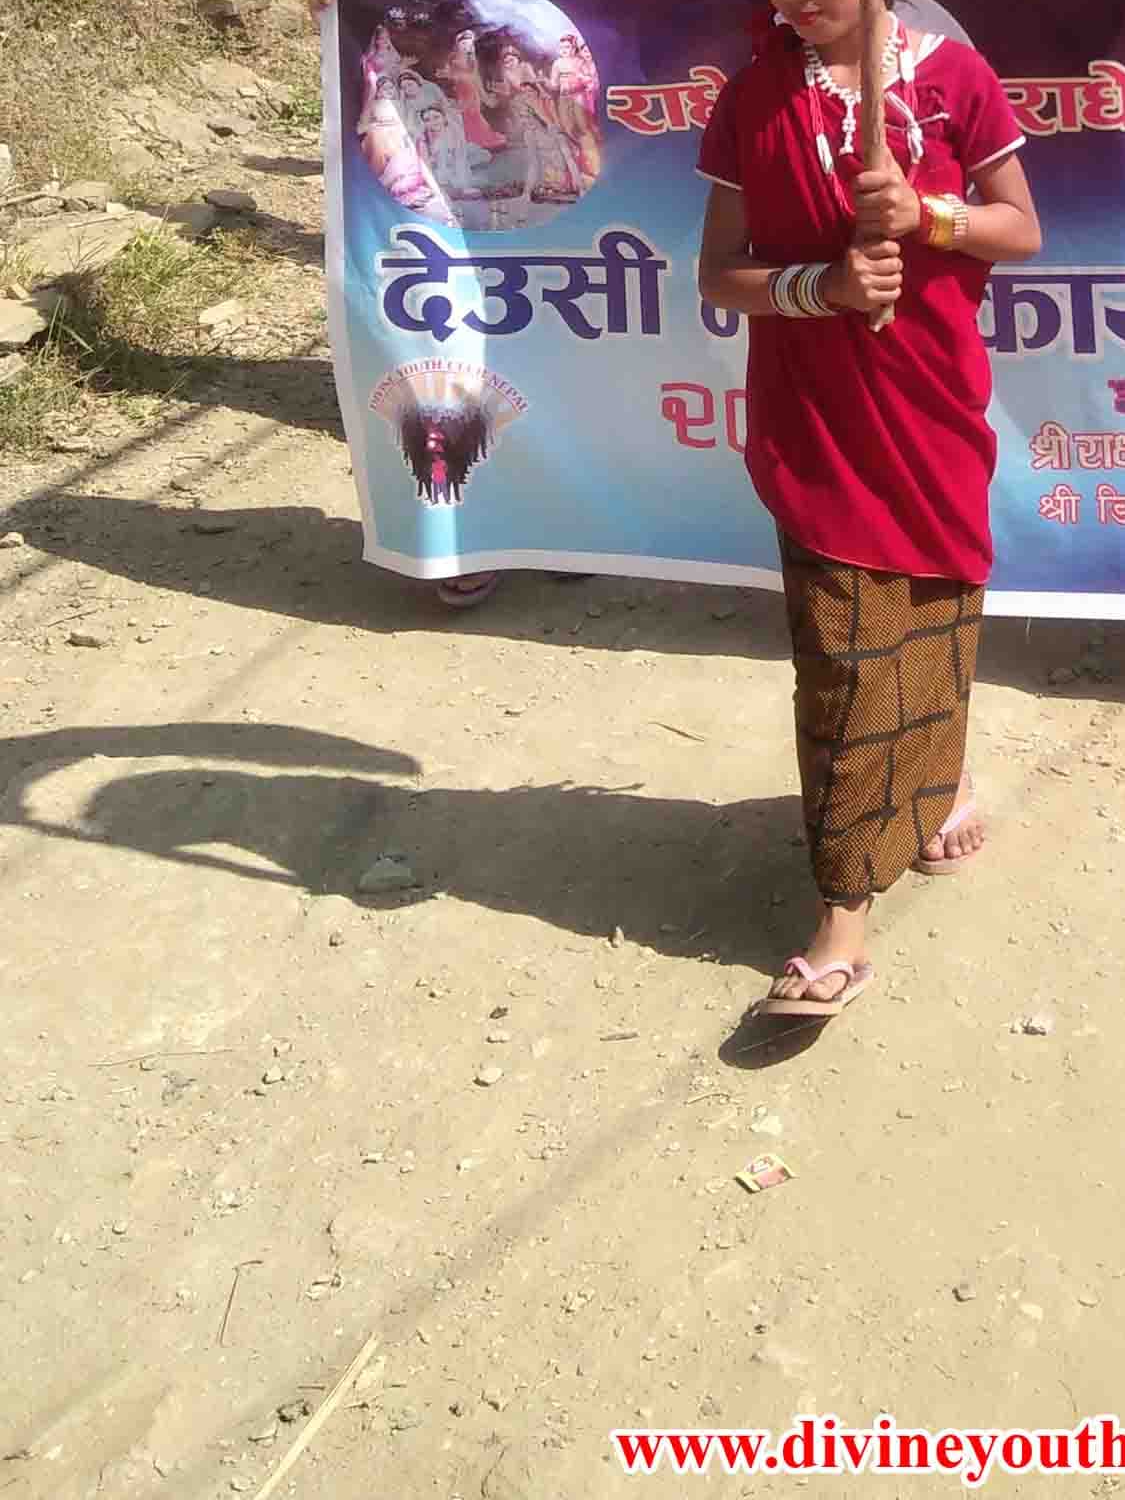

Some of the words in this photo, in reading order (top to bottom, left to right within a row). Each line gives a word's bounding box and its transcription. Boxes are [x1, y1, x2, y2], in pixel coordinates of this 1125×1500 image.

[380, 228, 668, 342] देउसी
[1031, 421, 1070, 471] श्री
[1037, 483, 1081, 526] श्री
